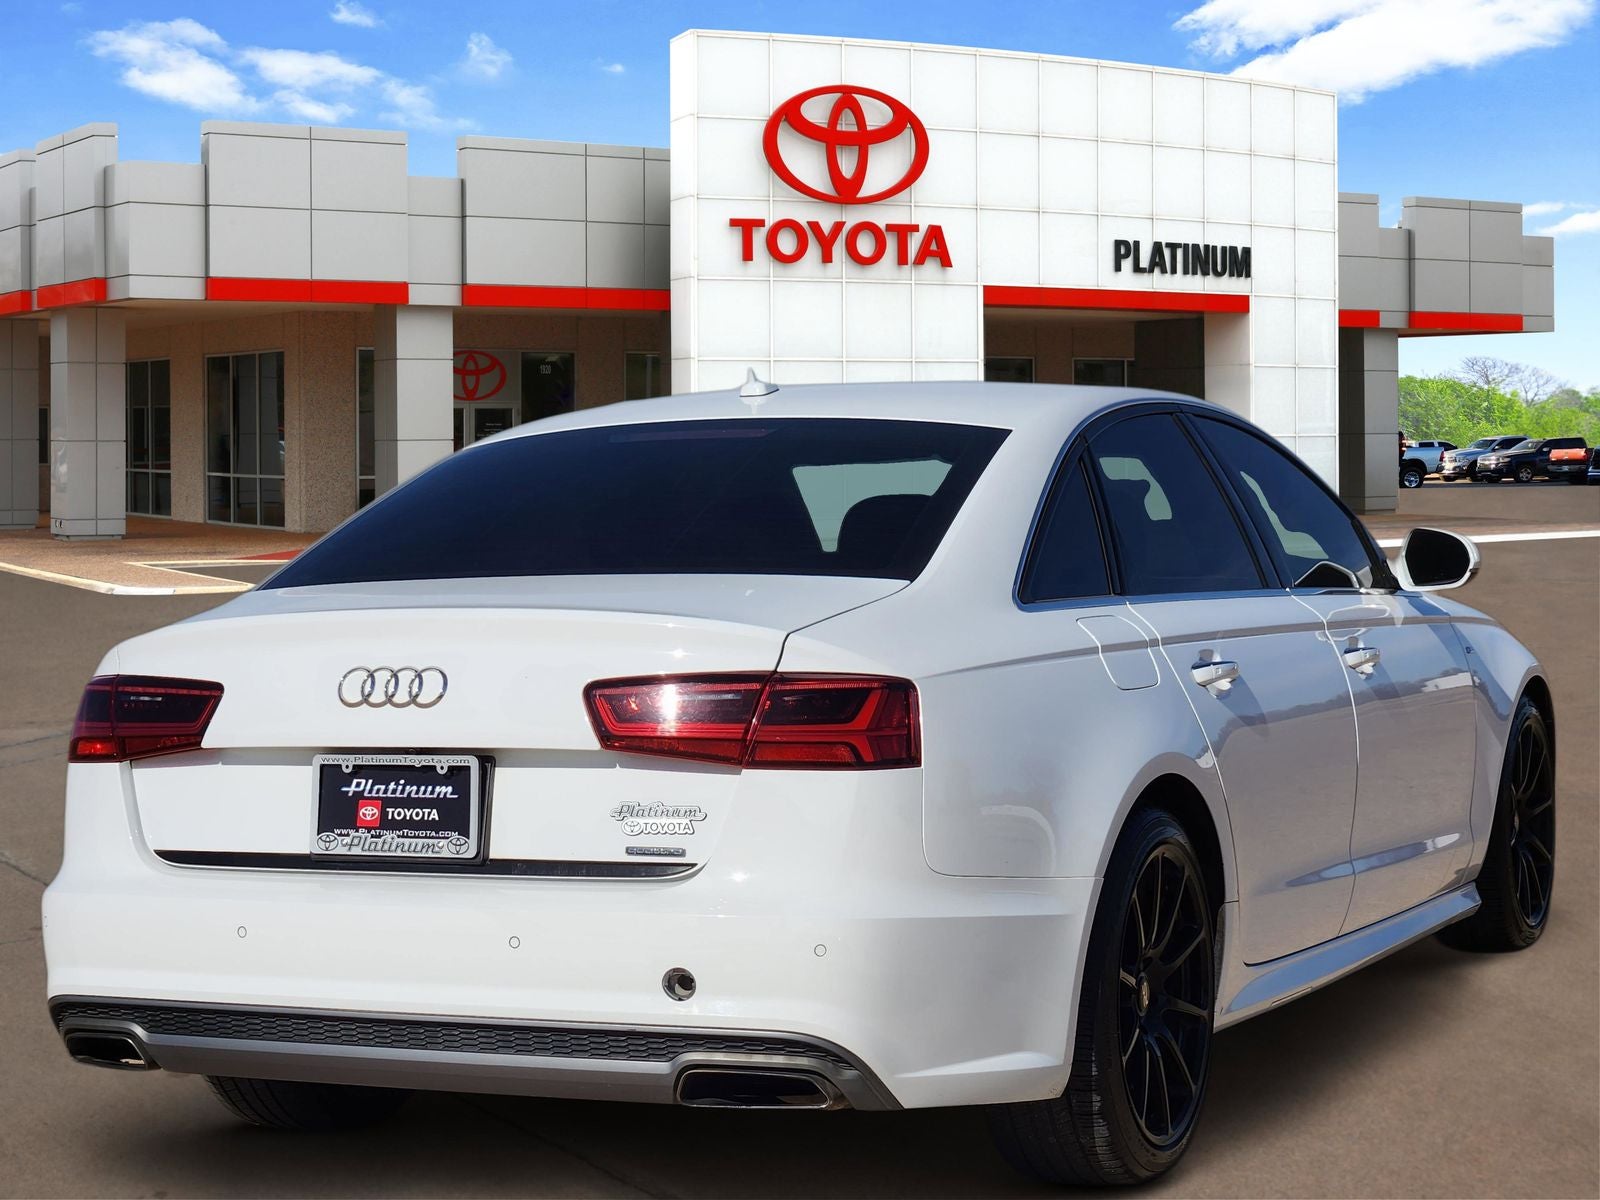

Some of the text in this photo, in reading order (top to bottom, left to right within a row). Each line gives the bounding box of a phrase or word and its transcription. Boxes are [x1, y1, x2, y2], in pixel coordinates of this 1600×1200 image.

[729, 217, 953, 269] TOYOTA
[1114, 239, 1252, 278] PLATINUM
[321, 756, 470, 765] www.PlatinumToyota.com
[341, 779, 458, 798] Platinum
[386, 808, 439, 821] TOYOTA
[613, 804, 704, 818] Platinum
[643, 822, 692, 832] TOYOTA
[346, 834, 444, 854] Platinum
